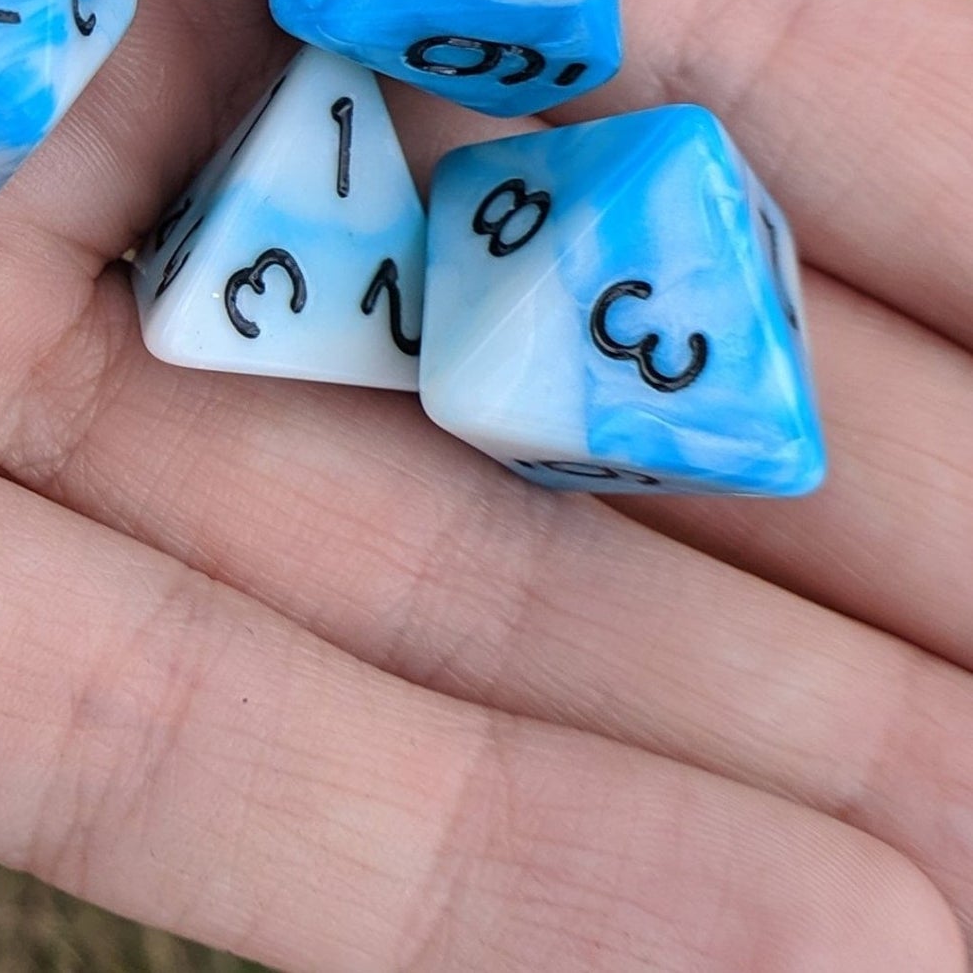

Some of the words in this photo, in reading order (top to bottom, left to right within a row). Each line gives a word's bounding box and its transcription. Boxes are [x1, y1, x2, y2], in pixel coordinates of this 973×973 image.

[330, 96, 355, 198] 1
[471, 177, 552, 258] 8
[224, 247, 308, 340] 3
[589, 279, 709, 393] 3
